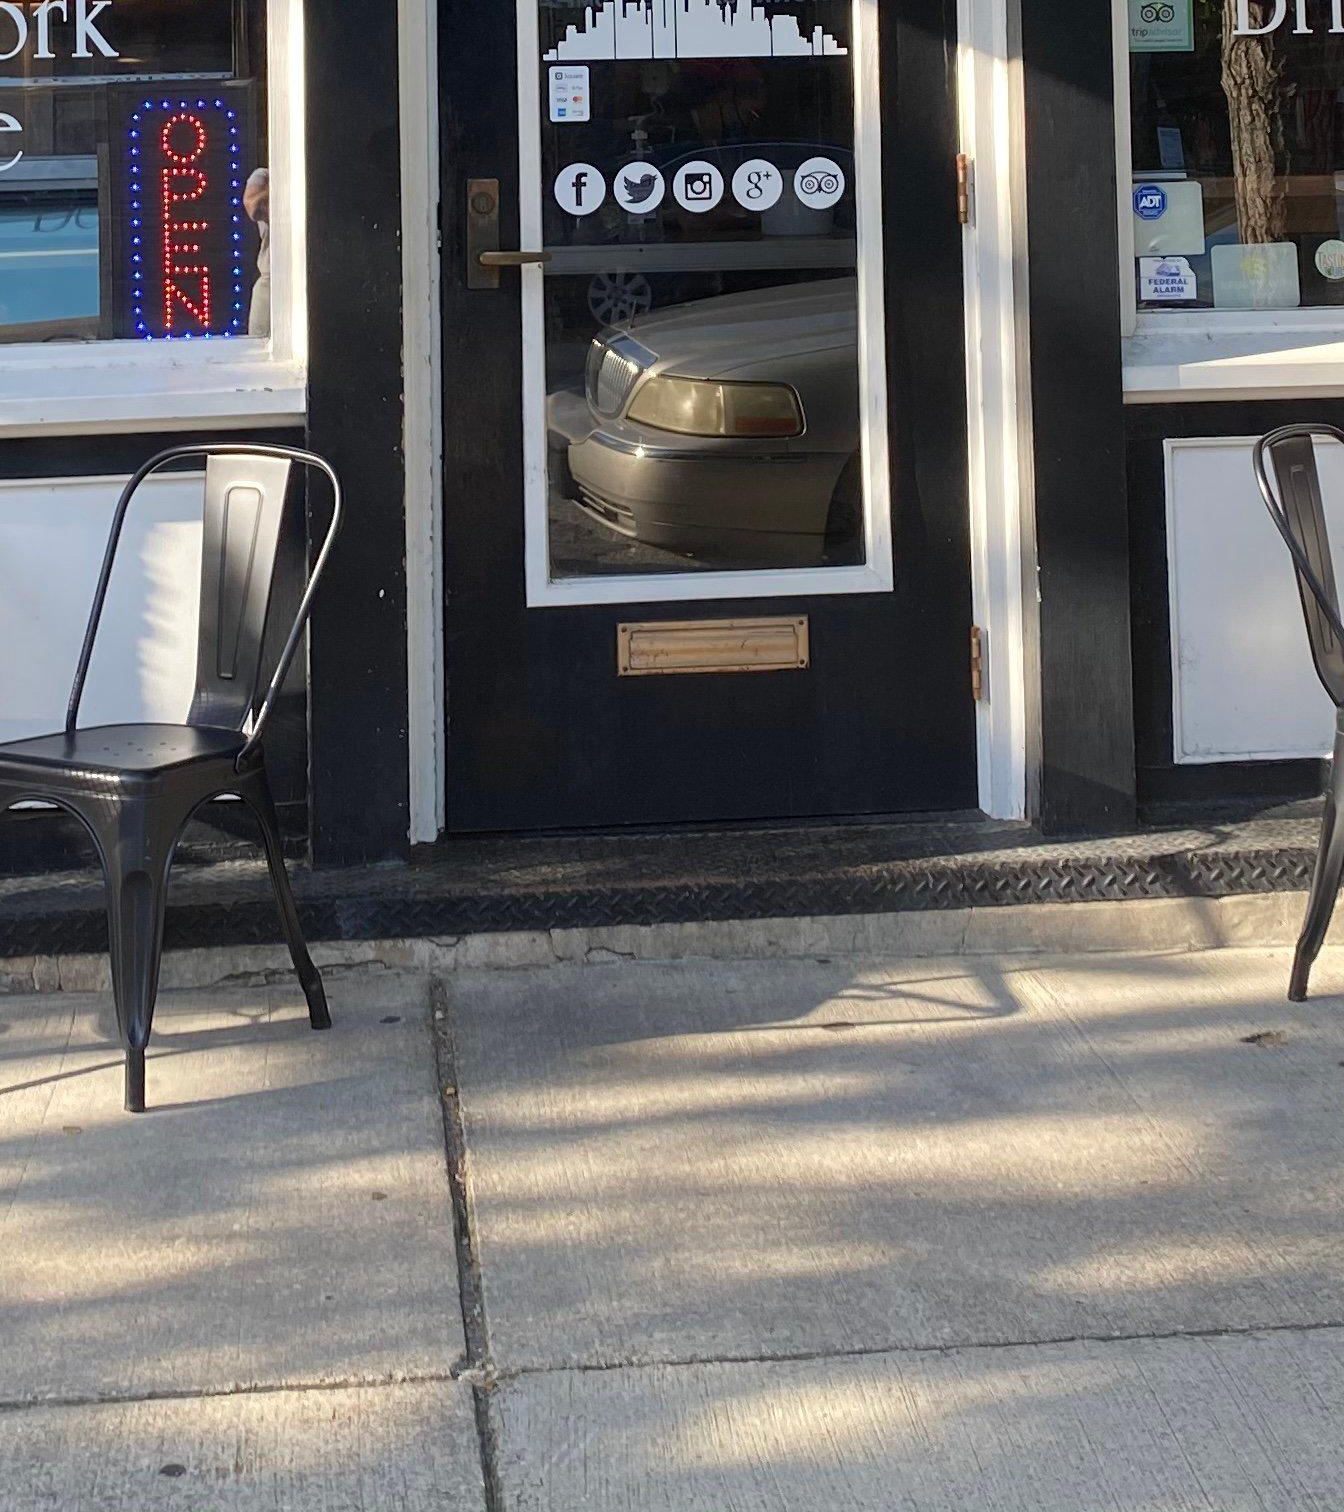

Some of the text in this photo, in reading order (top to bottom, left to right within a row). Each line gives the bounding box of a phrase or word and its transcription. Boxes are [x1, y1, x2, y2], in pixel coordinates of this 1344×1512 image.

[1139, 194, 1161, 208] ADT
[159, 112, 213, 331] OPEN
[1148, 278, 1189, 286] FEDERAL
[1152, 286, 1185, 294] ALARM
